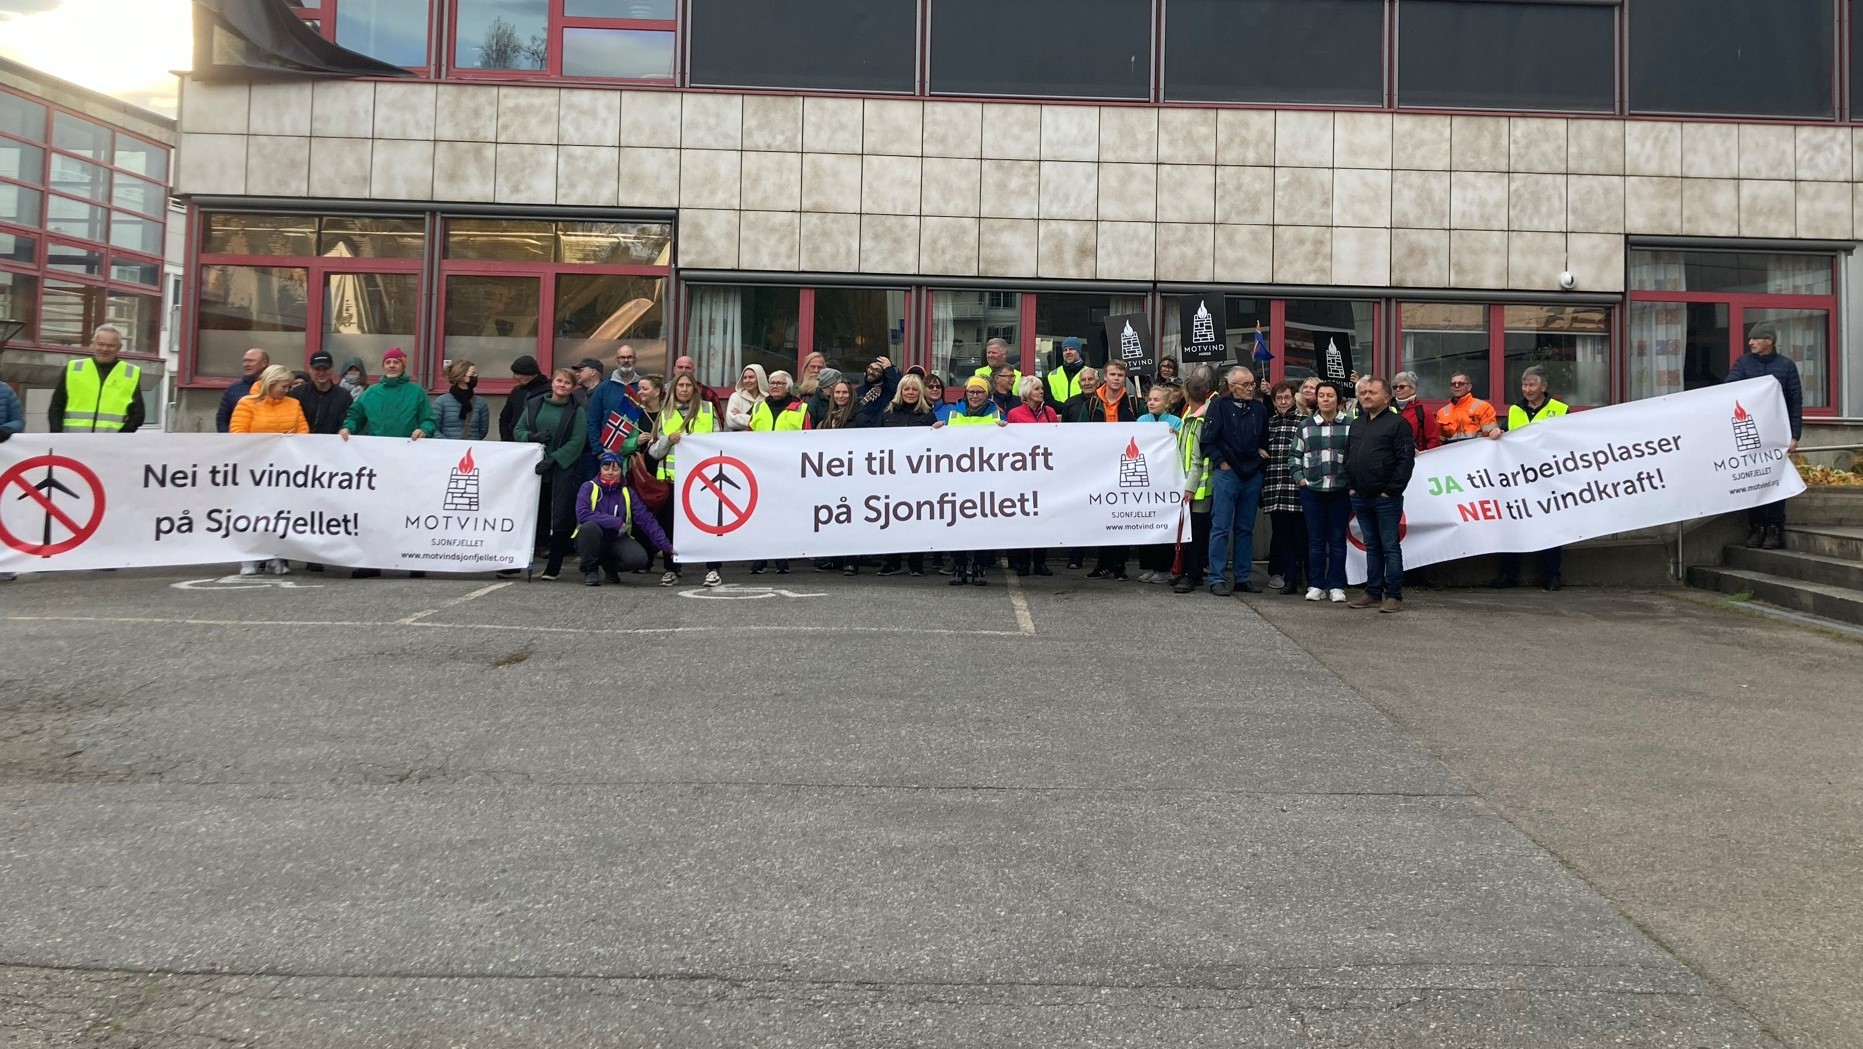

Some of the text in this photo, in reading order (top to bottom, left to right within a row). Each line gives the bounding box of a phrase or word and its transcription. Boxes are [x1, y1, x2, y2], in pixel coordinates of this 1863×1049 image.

[1184, 344, 1225, 353] MOTVIND
[800, 445, 1055, 478] Nei til vindkraft
[1427, 434, 1683, 496] JA til arbeidsplasser
[1713, 448, 1784, 472] MOTVIND
[142, 462, 377, 491] Nei til vindkraft
[1732, 467, 1772, 481] SJONFJELLET
[1456, 467, 1667, 523] NEI til vindkraft!
[1729, 479, 1780, 495] www.motvind.org
[1089, 491, 1181, 505] MOTVIND
[813, 489, 1039, 533] på Sjonfjellet!
[154, 509, 360, 541] på Sjonfjellet!
[405, 515, 515, 533] MOTVIND
[431, 538, 484, 547] SJONFJELLET
[401, 552, 514, 563] www.motvindsjonfjellet.org
